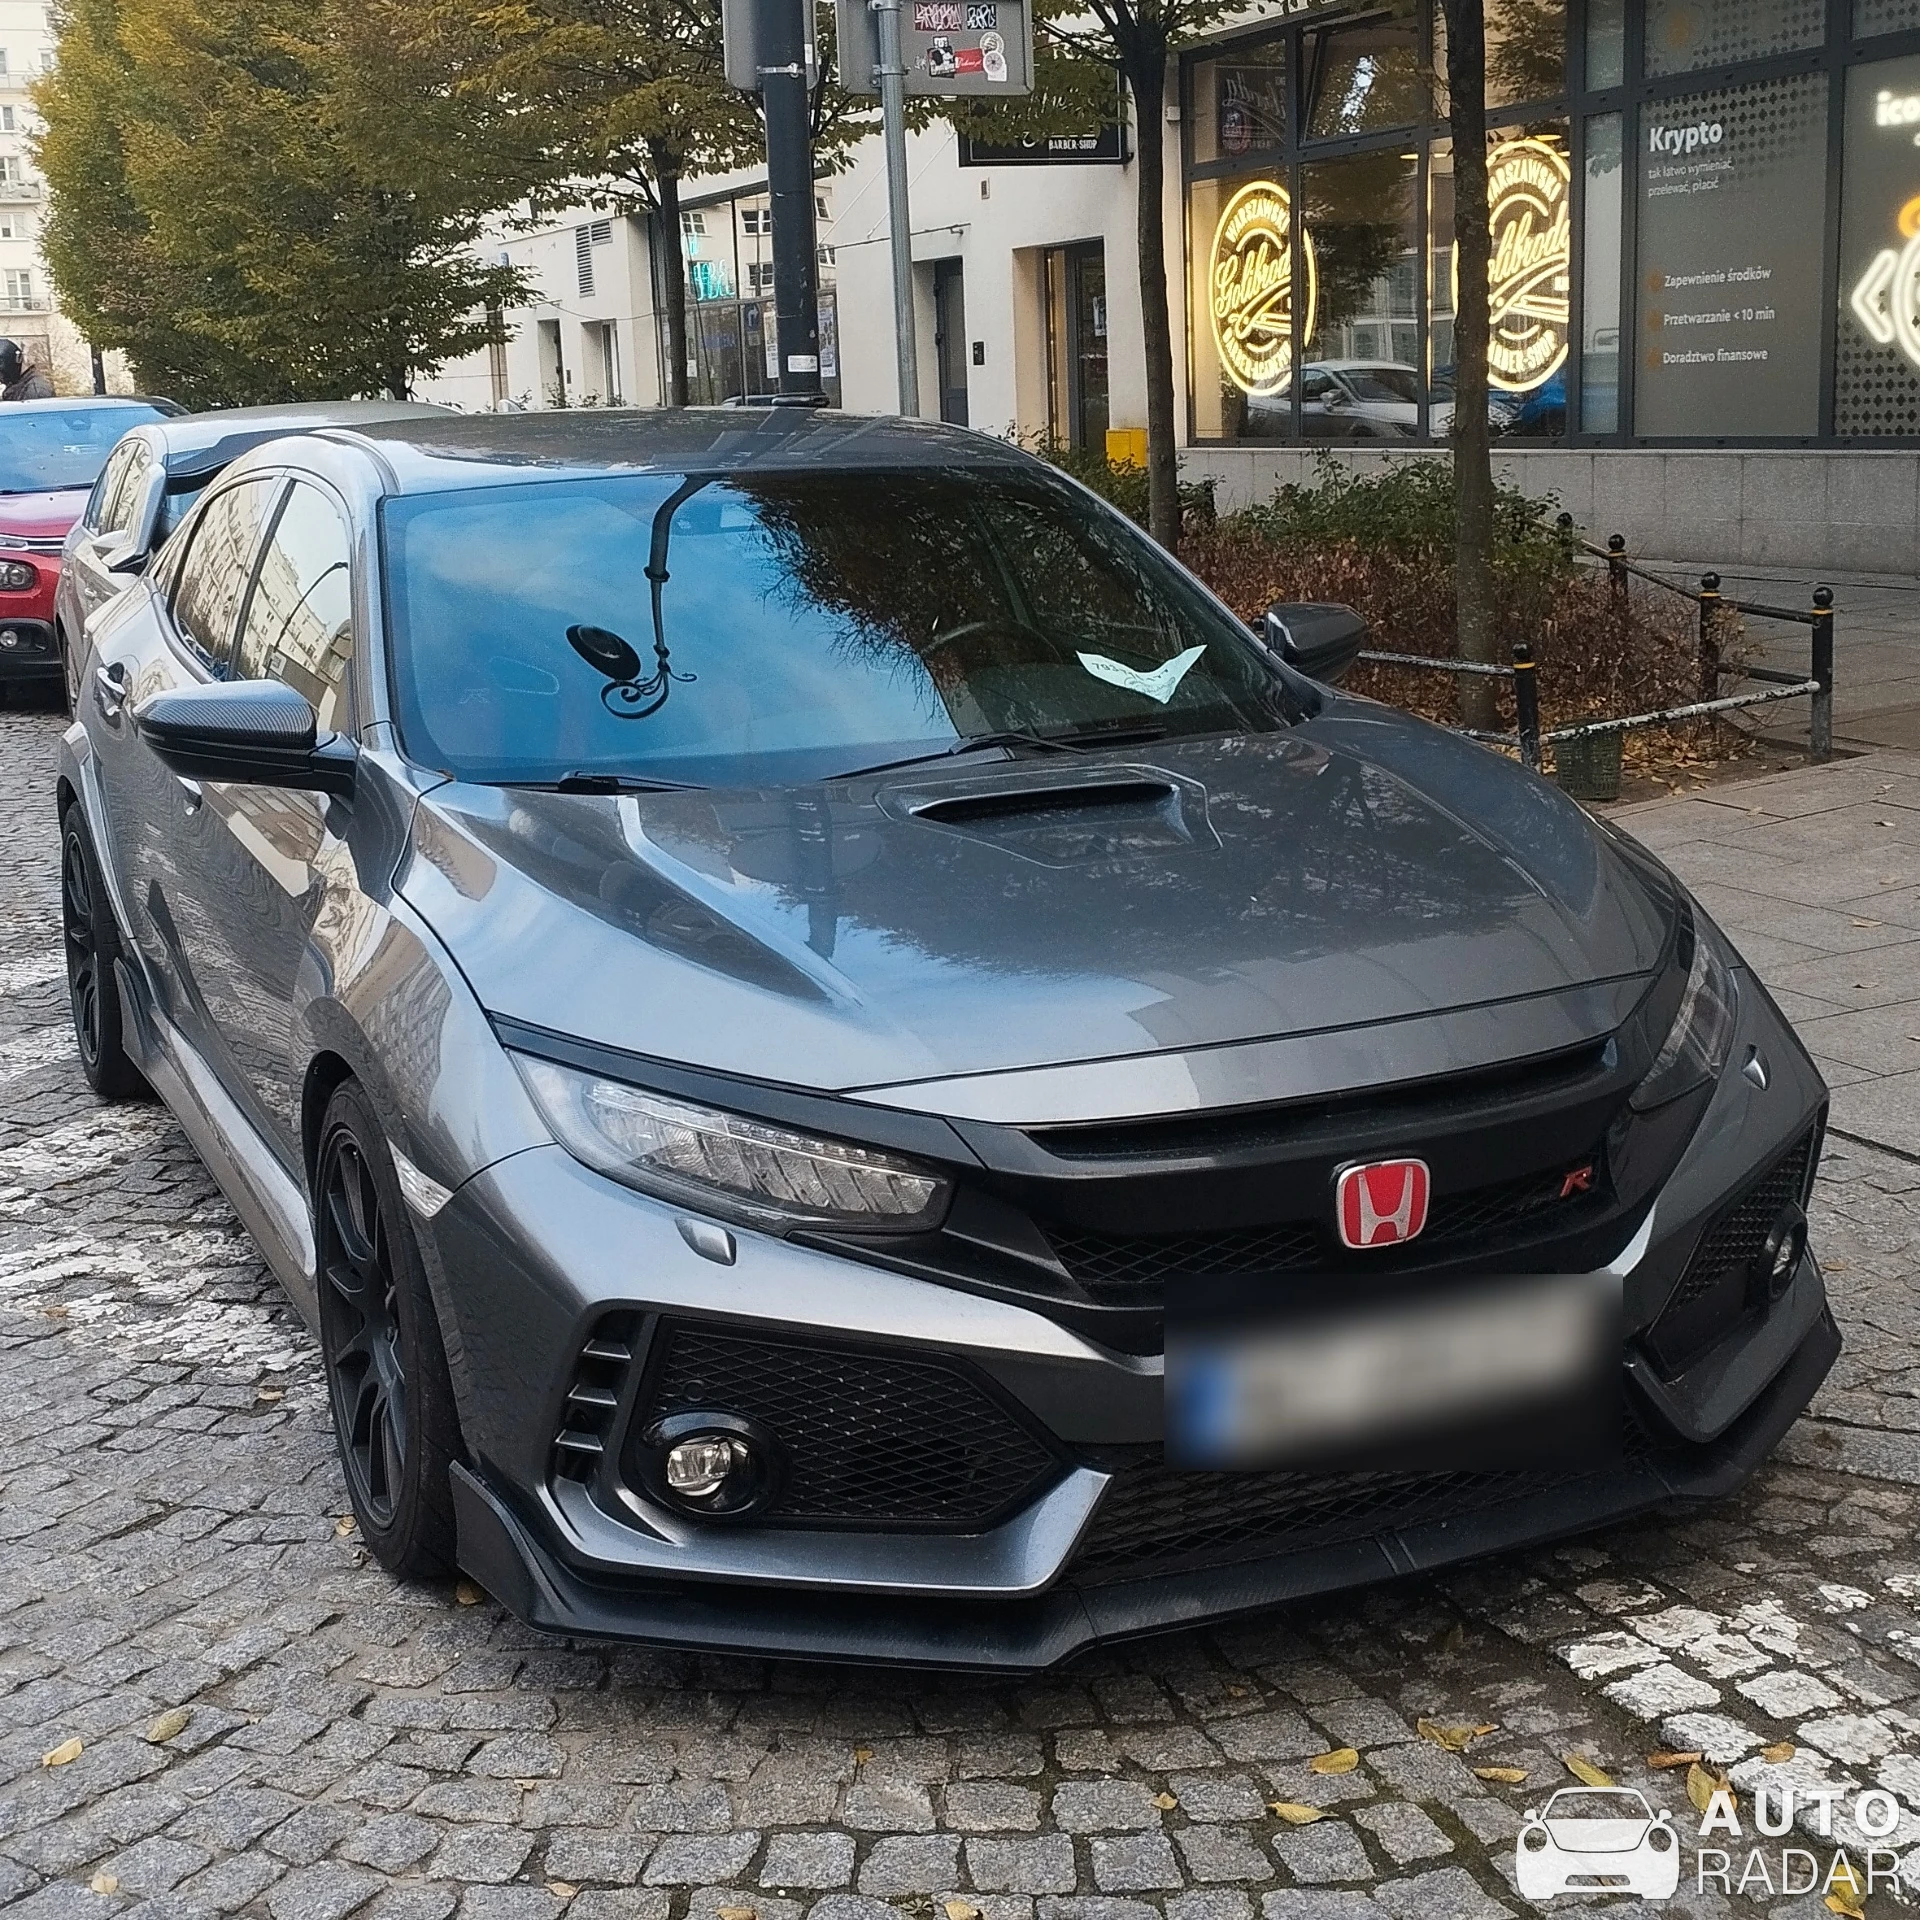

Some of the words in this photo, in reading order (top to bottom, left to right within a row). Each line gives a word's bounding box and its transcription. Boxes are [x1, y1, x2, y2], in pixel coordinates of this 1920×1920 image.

[1649, 121, 1723, 156] Krypto
[1648, 167, 1662, 179] tak
[1225, 198, 1291, 243] WARSZAWSKI
[1664, 270, 1726, 289] Zapewnienie
[1727, 265, 1772, 282] środków
[1663, 308, 1731, 326] Przetwarzanie
[1741, 308, 1754, 321] 10
[1755, 306, 1775, 320] min
[1663, 350, 1715, 364] Doradztwo
[1717, 348, 1768, 362] finansowe
